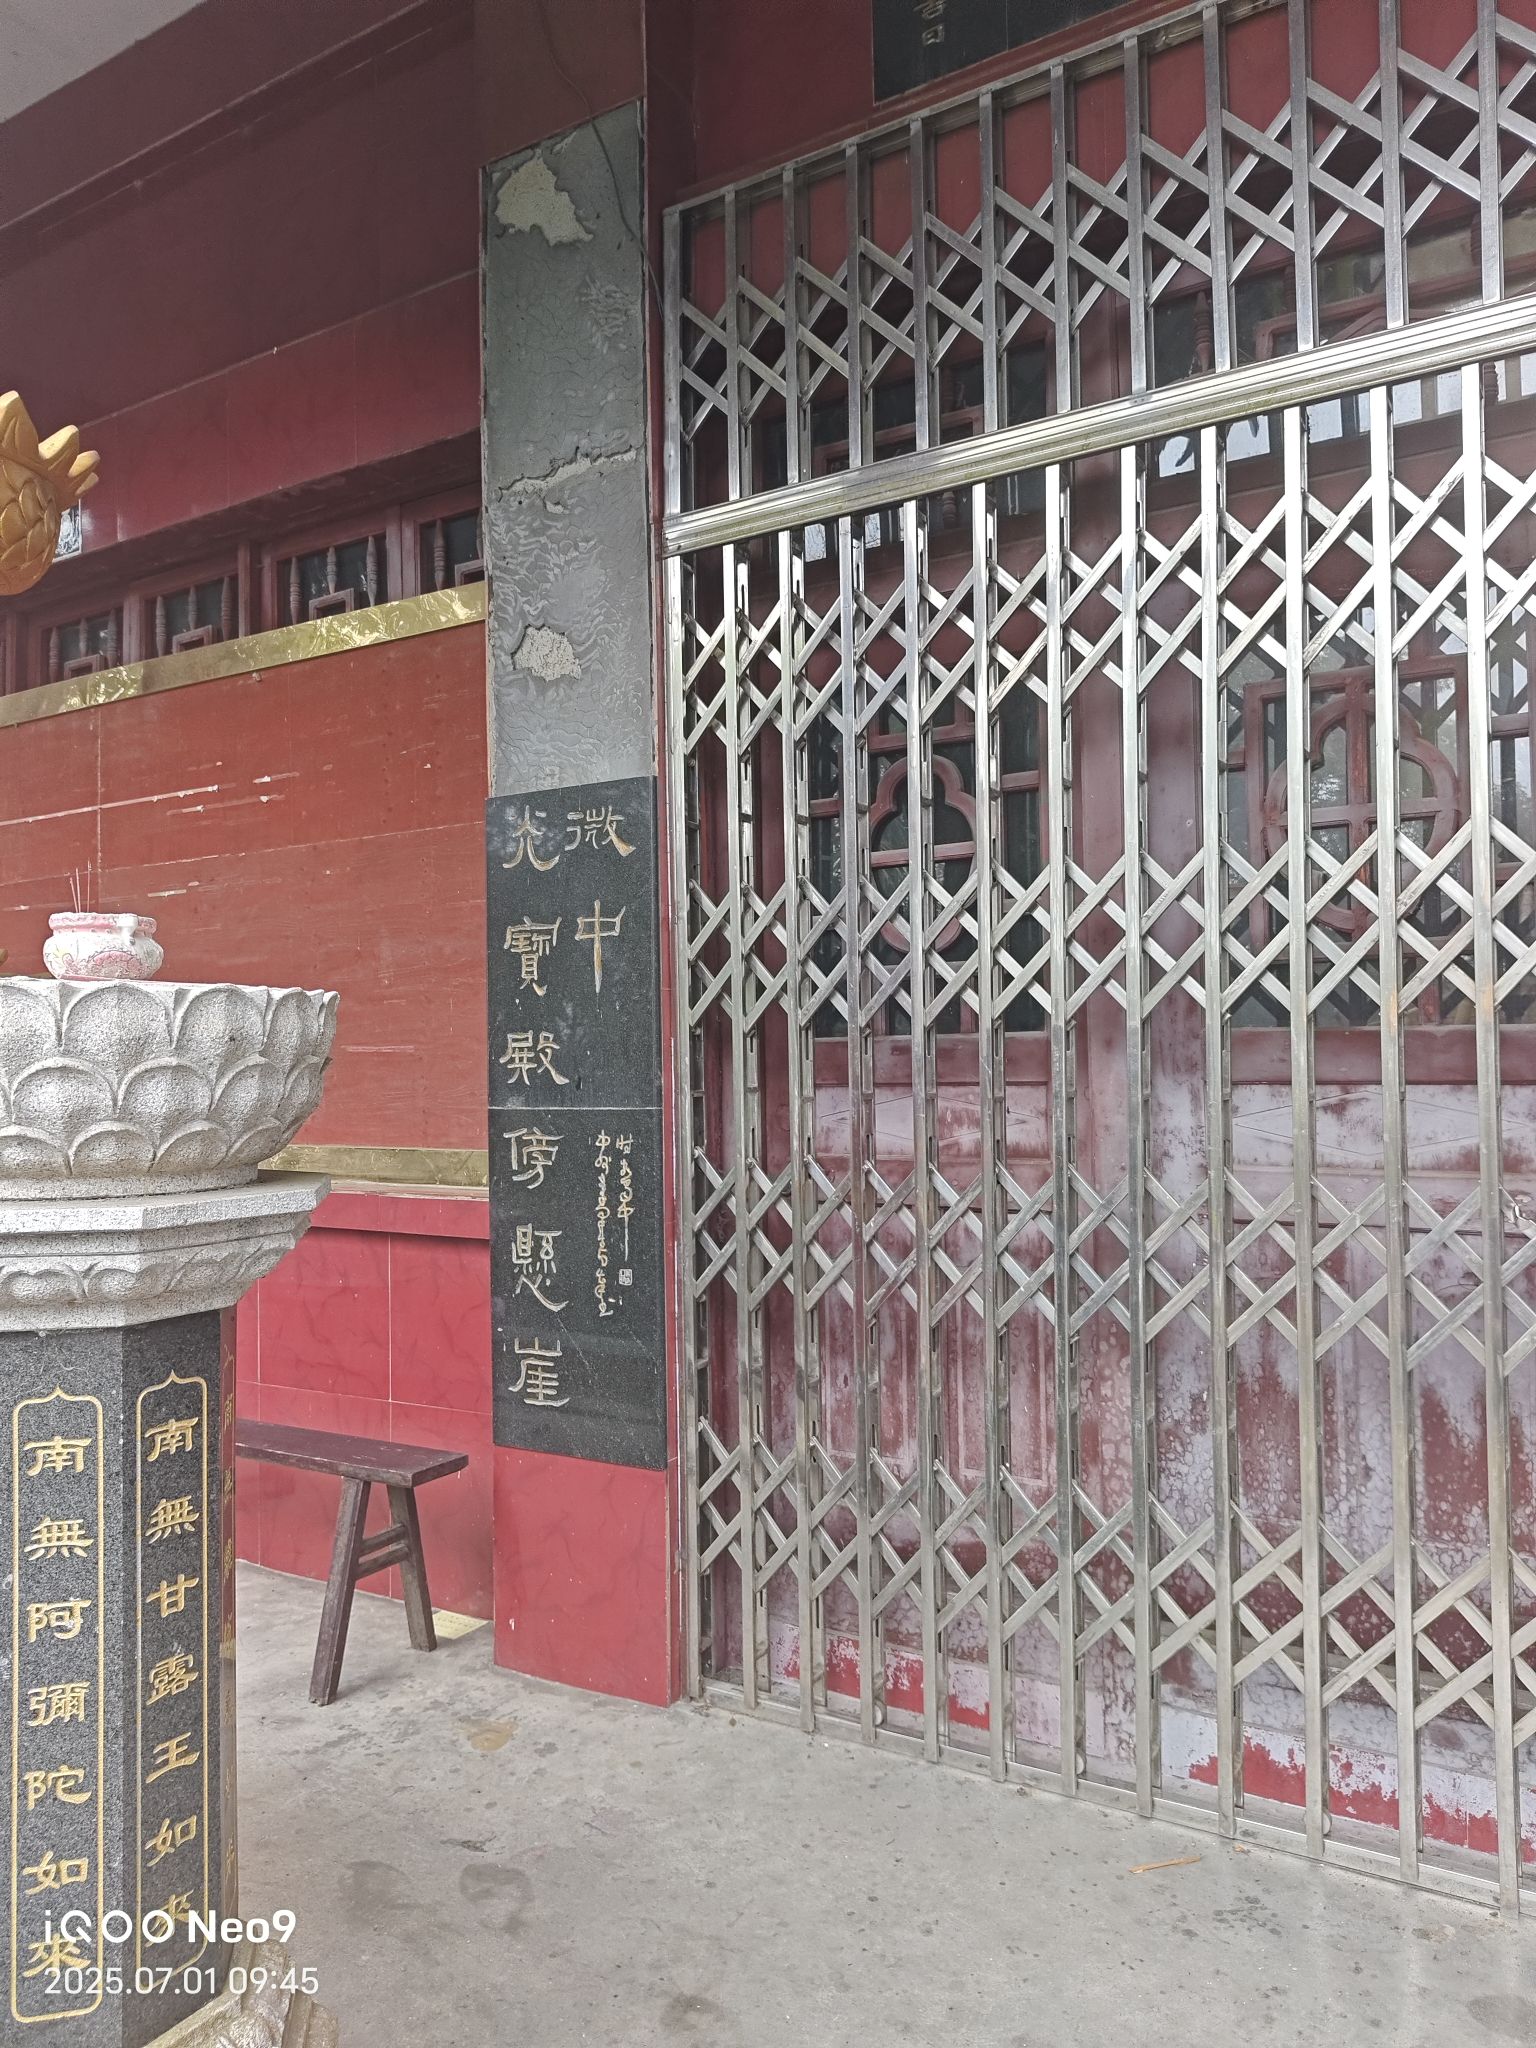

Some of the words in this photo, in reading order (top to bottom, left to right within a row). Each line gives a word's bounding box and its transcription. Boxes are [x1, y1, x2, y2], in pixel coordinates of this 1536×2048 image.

[564, 805, 636, 994] 微中
[23, 1436, 94, 1978] 南無阿彌陀如來
